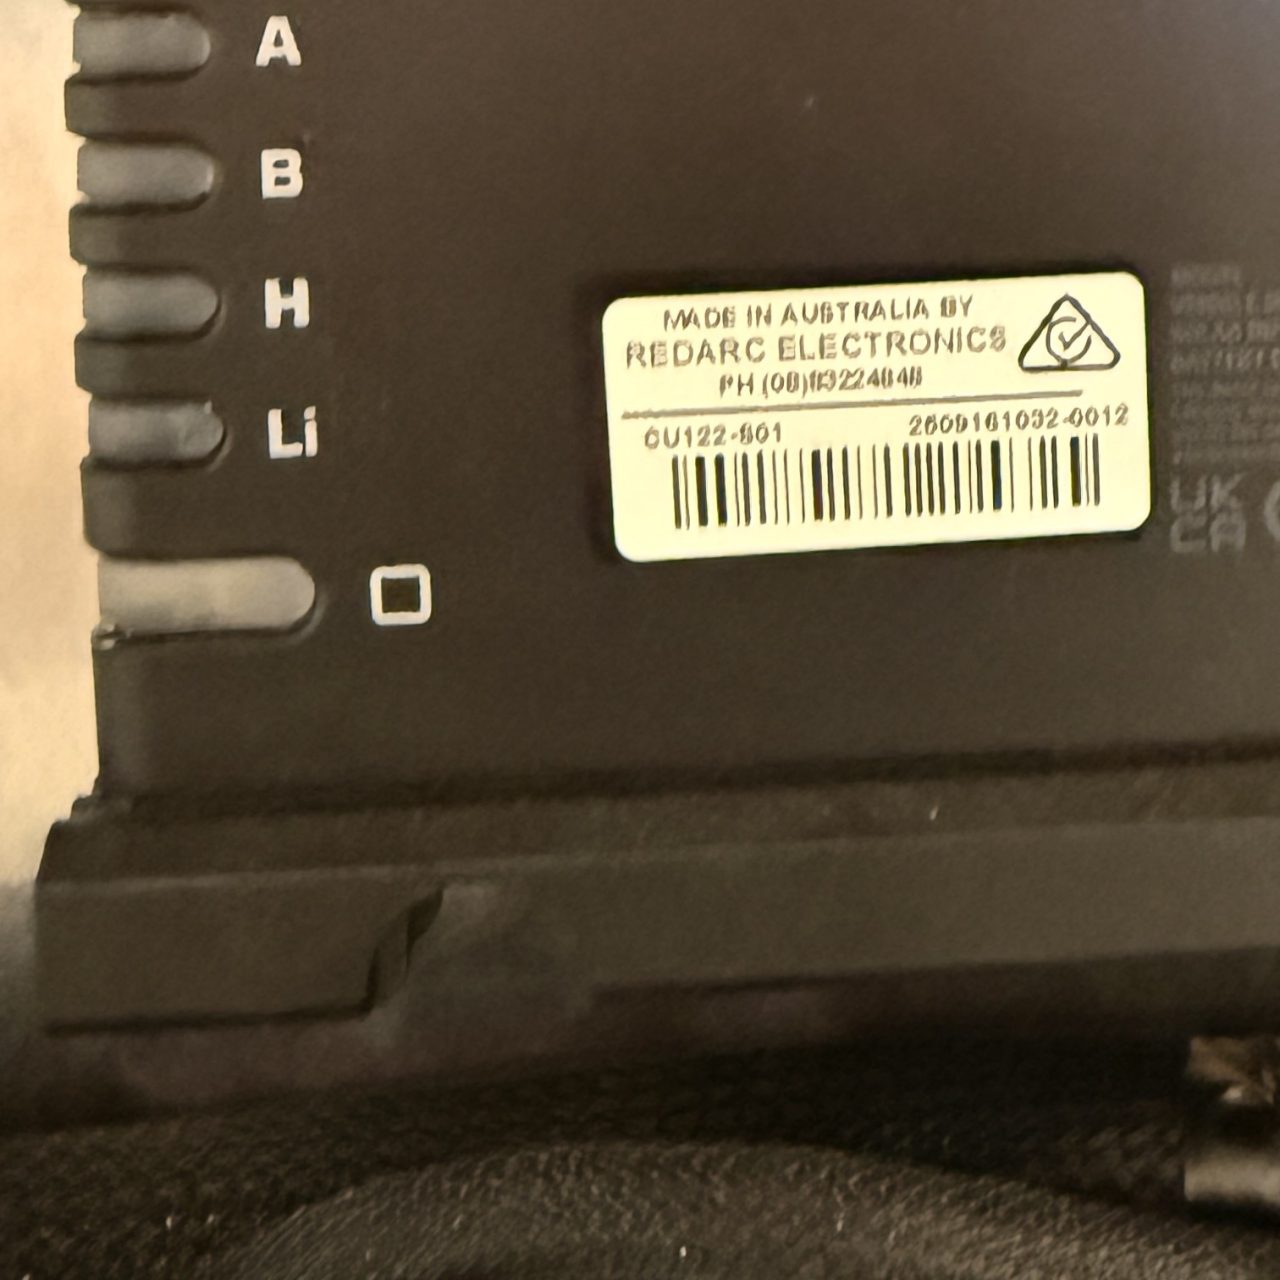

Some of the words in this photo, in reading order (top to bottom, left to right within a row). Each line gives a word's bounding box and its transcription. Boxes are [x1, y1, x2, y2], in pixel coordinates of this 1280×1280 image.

[255, 15, 302, 67] A
[260, 148, 304, 199] B
[264, 277, 310, 329] H
[663, 306, 736, 332] MADE
[746, 303, 772, 328] IN
[780, 297, 930, 325] AUSTRALIA
[940, 295, 973, 318] BY
[626, 337, 766, 369] REDARC
[777, 325, 1007, 362] ELECTRONICS
[719, 372, 754, 398] PH
[267, 405, 318, 459] Li
